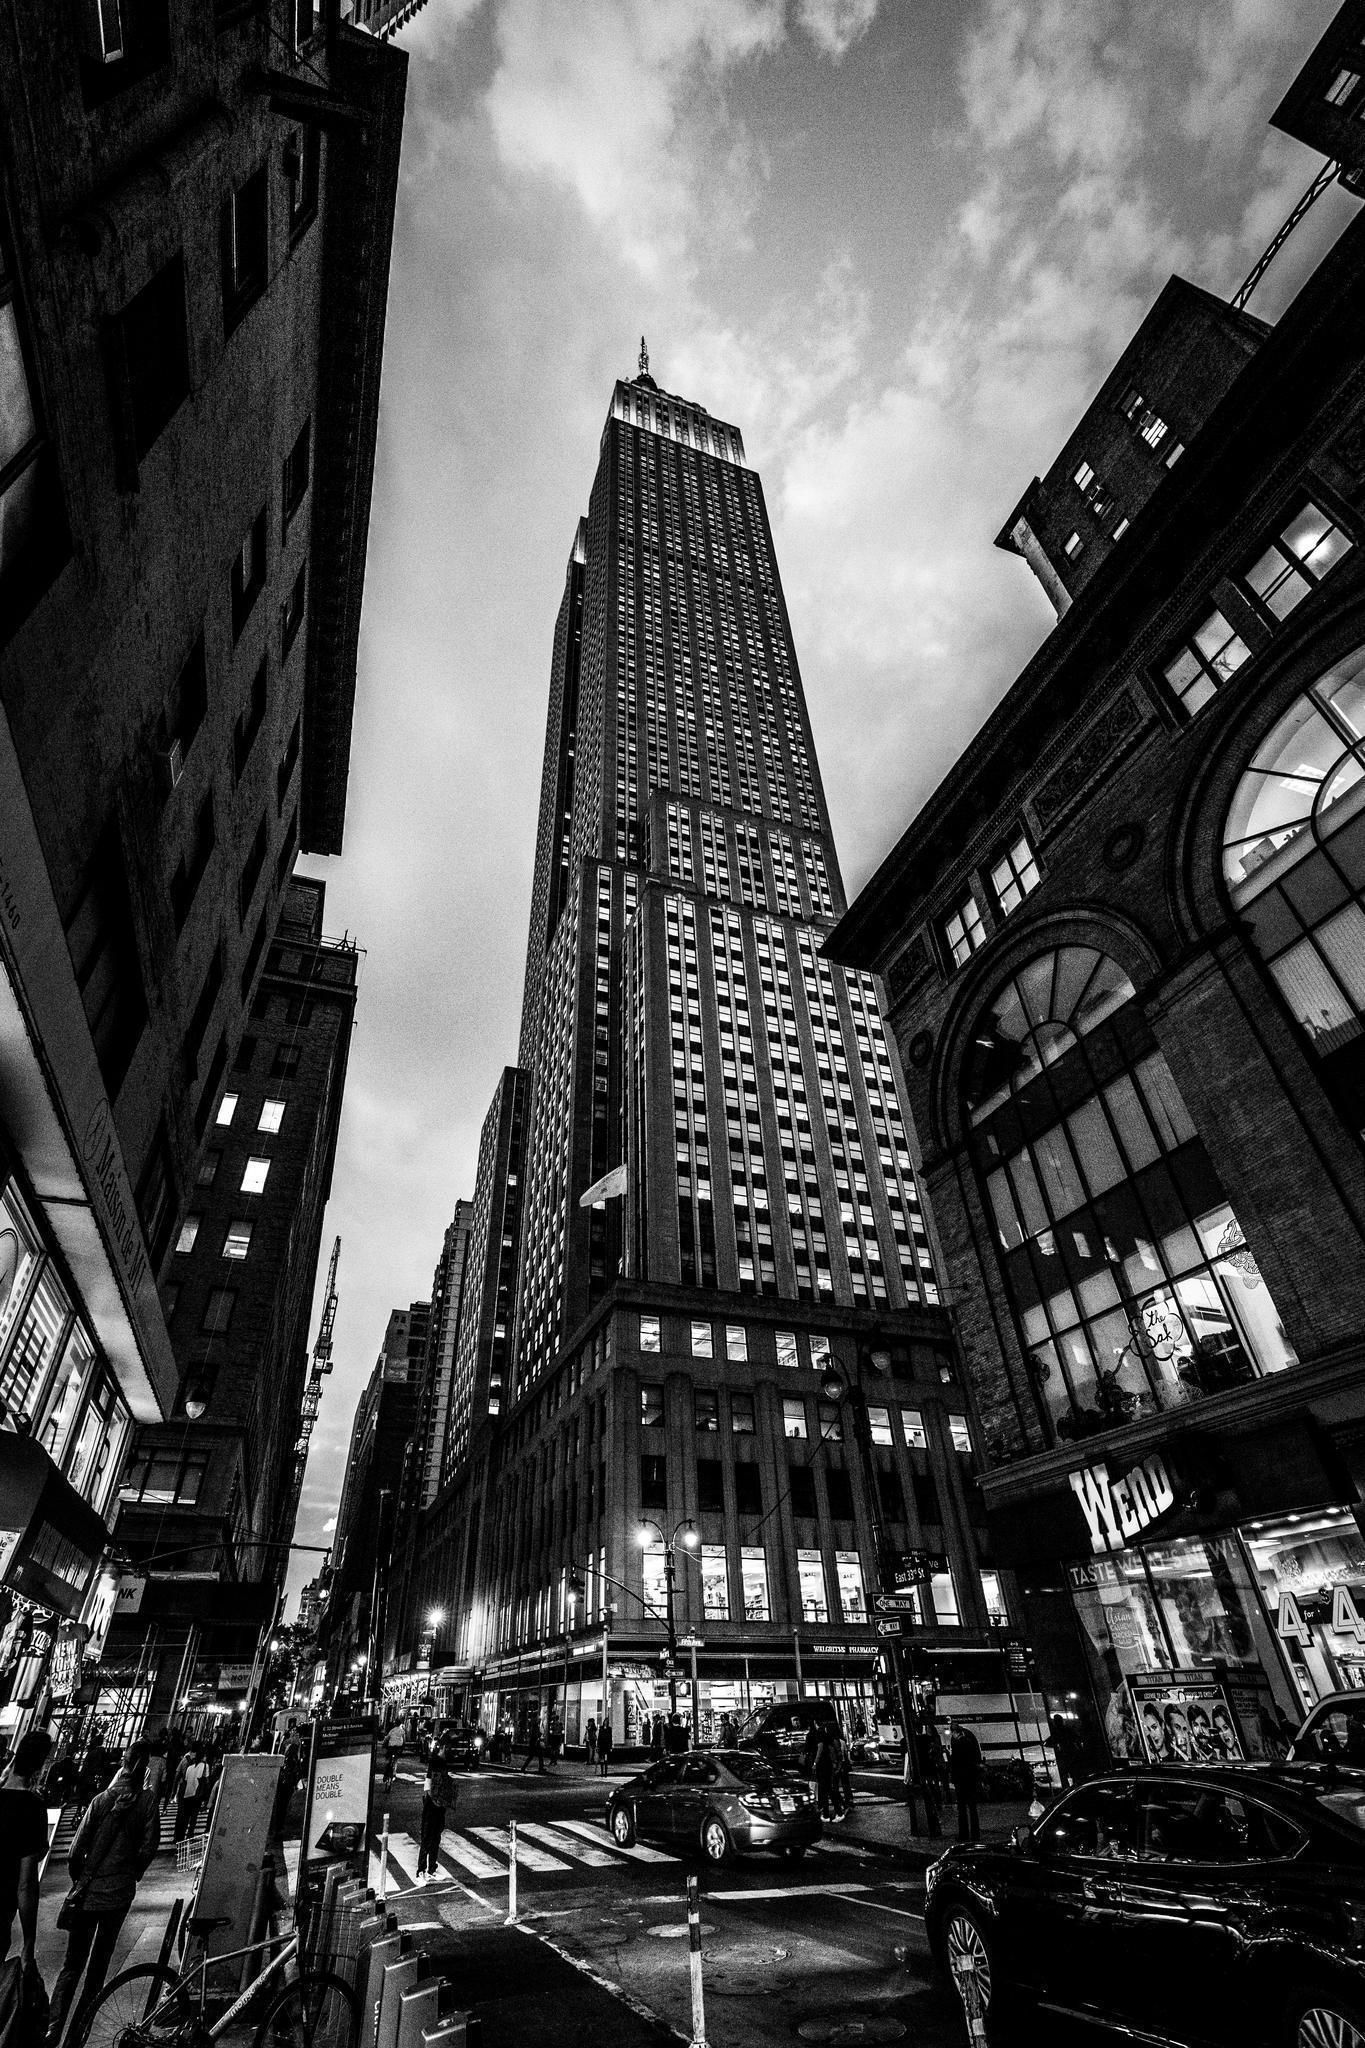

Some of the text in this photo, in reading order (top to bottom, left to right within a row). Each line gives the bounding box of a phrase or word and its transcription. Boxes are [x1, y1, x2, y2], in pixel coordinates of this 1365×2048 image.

[96, 1134, 126, 1243] Maison
[121, 1221, 134, 1264] de
[1146, 1310, 1166, 1327] the
[1146, 1323, 1173, 1349] Sak
[928, 1560, 939, 1569] ve
[1069, 1560, 1117, 1586] TASTE
[1187, 1537, 1238, 1568] NEW!
[894, 1567, 926, 1583] East 33rd St
[880, 1599, 907, 1608] ONE WAY
[1278, 1591, 1314, 1647] 4
[1303, 1609, 1315, 1621] for
[880, 1621, 898, 1631] ONE WAY
[848, 1646, 879, 1654] PHARMACY
[1184, 1672, 1204, 1681] TITAN
[317, 1774, 344, 1785] DOUBLE
[316, 1783, 340, 1793] MEANS
[315, 1790, 344, 1800] DOUBLE.
